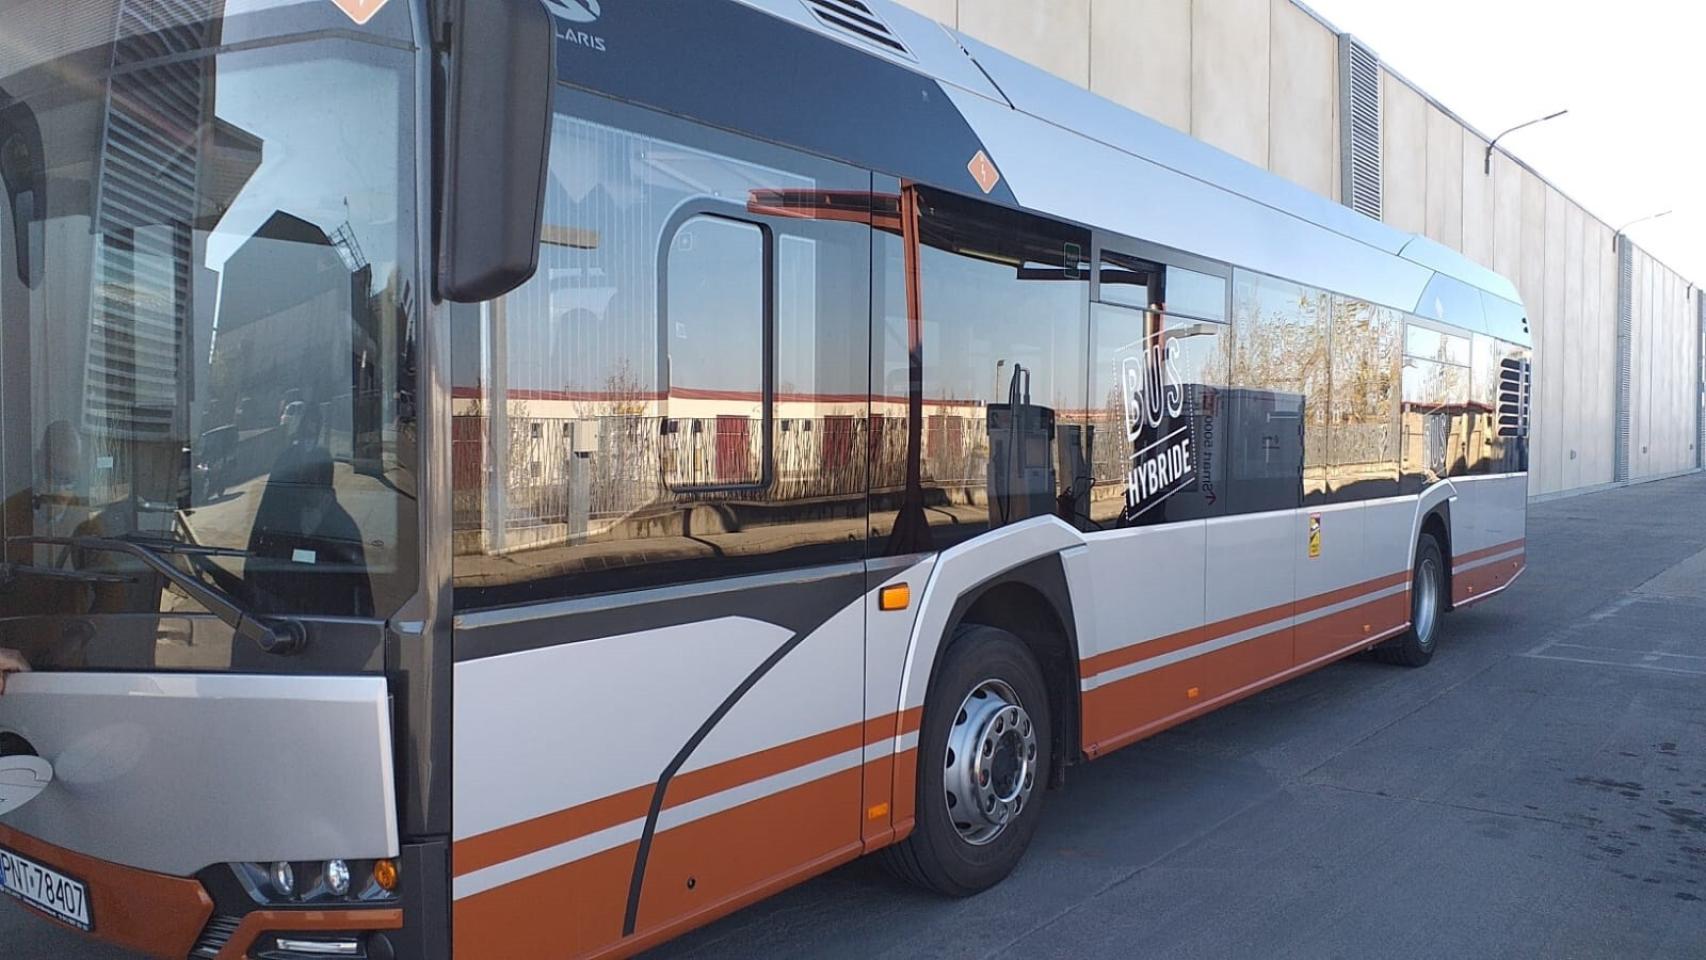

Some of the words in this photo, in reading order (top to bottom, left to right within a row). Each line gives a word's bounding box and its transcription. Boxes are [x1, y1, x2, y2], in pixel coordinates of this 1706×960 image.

[1122, 336, 1184, 442] BUS
[1128, 437, 1192, 508] HYBRIDE
[34, 867, 83, 917] 78407
